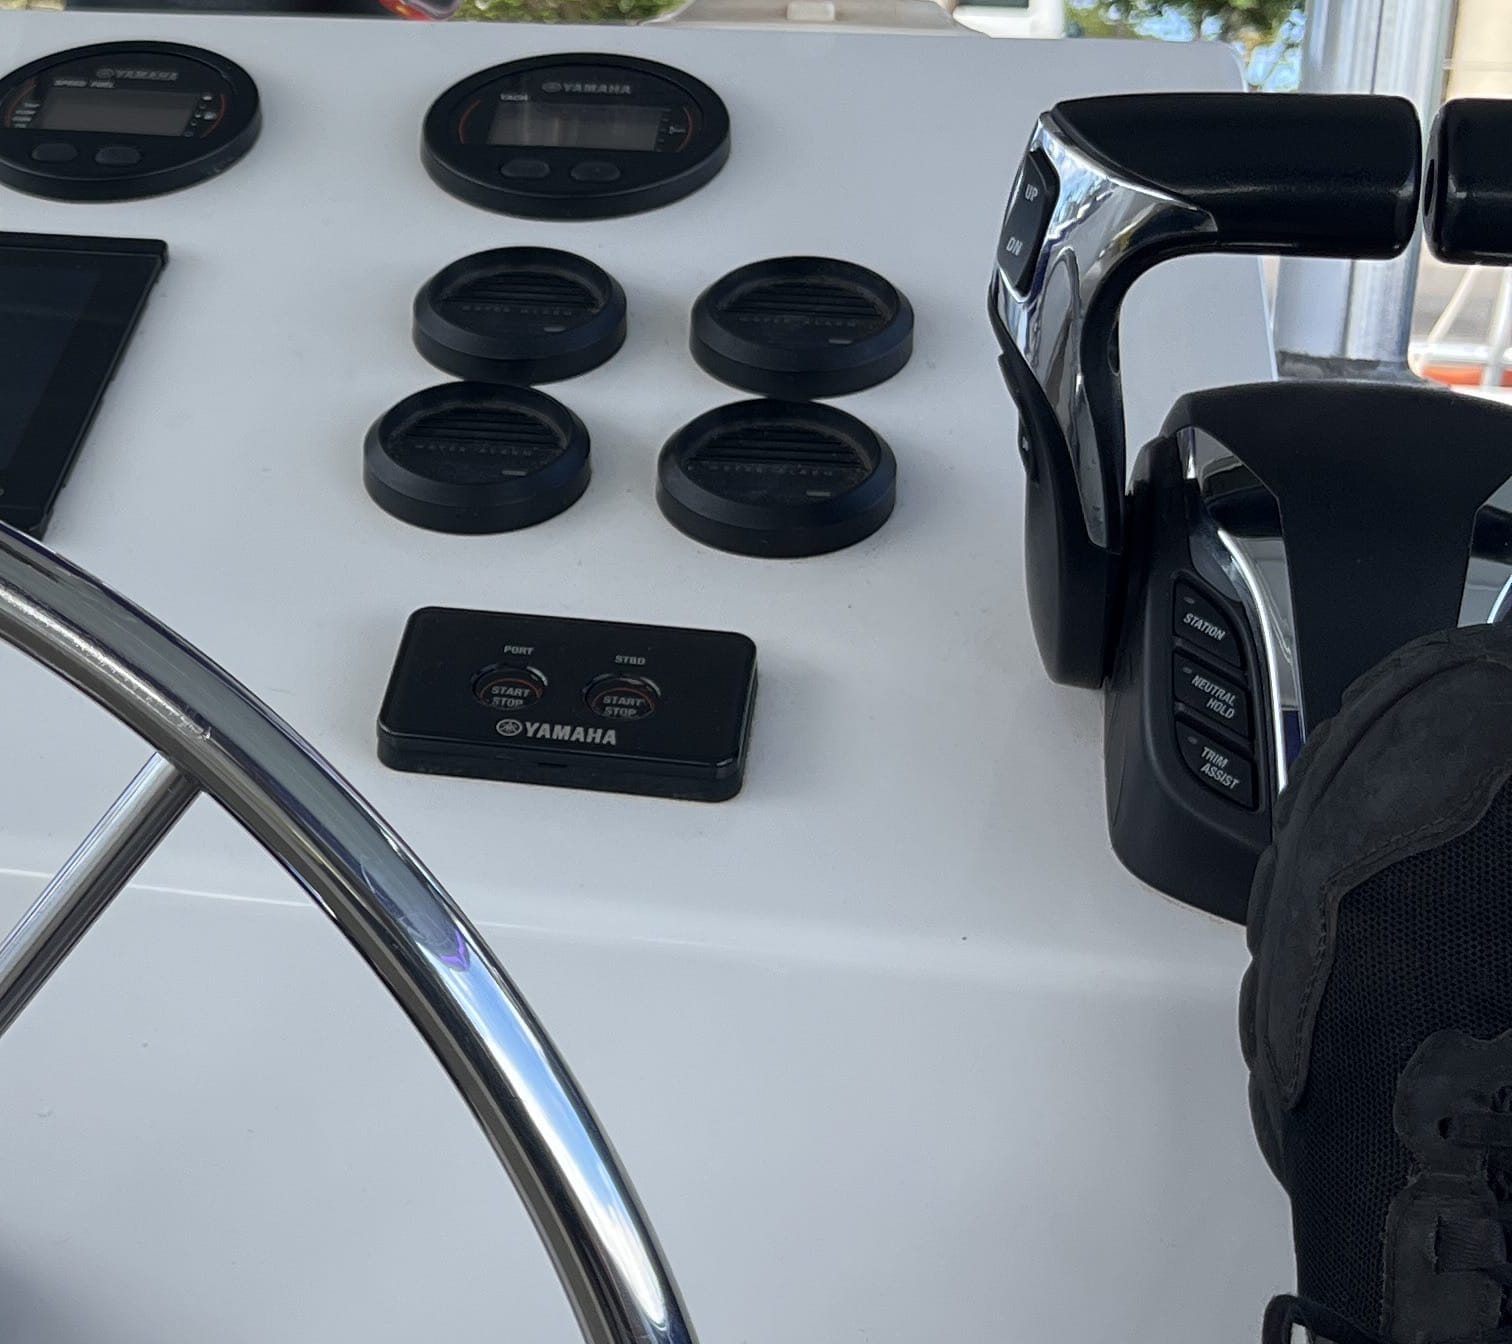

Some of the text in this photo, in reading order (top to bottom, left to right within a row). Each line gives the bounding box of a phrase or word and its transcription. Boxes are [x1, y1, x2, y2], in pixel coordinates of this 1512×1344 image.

[562, 82, 632, 95] YAMAHA
[1025, 183, 1039, 201] UP
[1006, 236, 1023, 256] DN
[1183, 612, 1226, 641] STATION
[503, 645, 534, 655] PORT
[615, 655, 646, 666] STBD
[491, 685, 530, 697] START
[1191, 674, 1236, 706] NEUTRAL
[492, 697, 524, 707] STOP
[603, 695, 645, 707] START
[1206, 697, 1236, 719] HOLD
[604, 707, 637, 717] STOP
[525, 721, 617, 745] YAMAHA
[1201, 746, 1229, 769] TRIM
[1200, 763, 1240, 790] ASSIST
